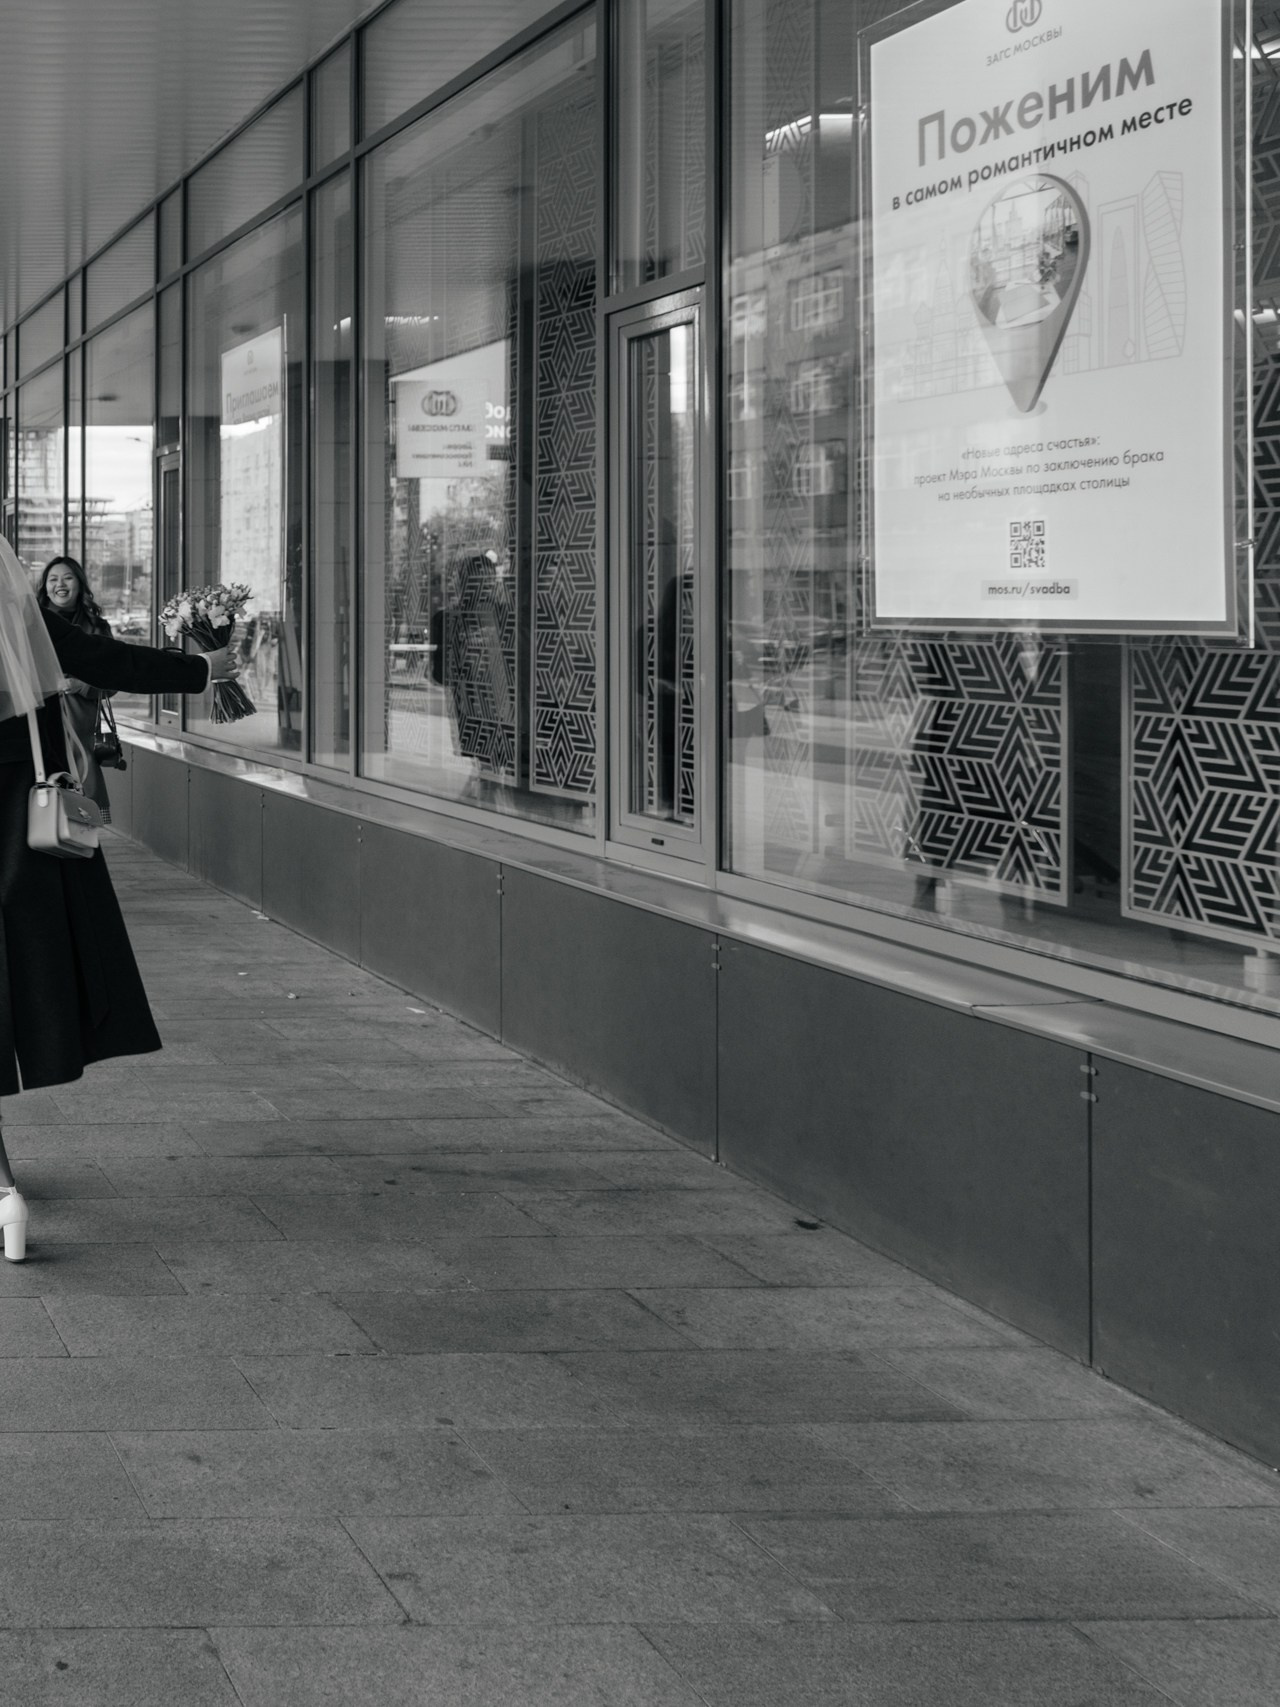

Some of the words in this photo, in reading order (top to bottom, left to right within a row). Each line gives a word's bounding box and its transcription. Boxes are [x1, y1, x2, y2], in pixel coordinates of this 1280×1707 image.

[985, 48, 1012, 67] ЗАГС
[1013, 26, 1063, 55] МОСКВЫ
[918, 48, 1156, 167] Поженим
[892, 195, 901, 211] в
[905, 176, 963, 206] самом
[968, 126, 1115, 192] романтичном
[1120, 97, 1193, 137] месте
[1003, 441, 1044, 459] адреса
[1047, 435, 1101, 451] счастья»:
[913, 473, 947, 486] проект
[949, 469, 978, 484] Мэра
[980, 465, 1023, 479] Москвы
[1026, 464, 1041, 475] по
[1044, 454, 1120, 473] заключению
[1123, 449, 1165, 468] брака
[938, 491, 951, 503] на
[953, 487, 1011, 503] необычных
[1013, 480, 1077, 498] площадках
[1080, 475, 1131, 492] столицы
[988, 583, 1071, 597] mos.ru/svadba
